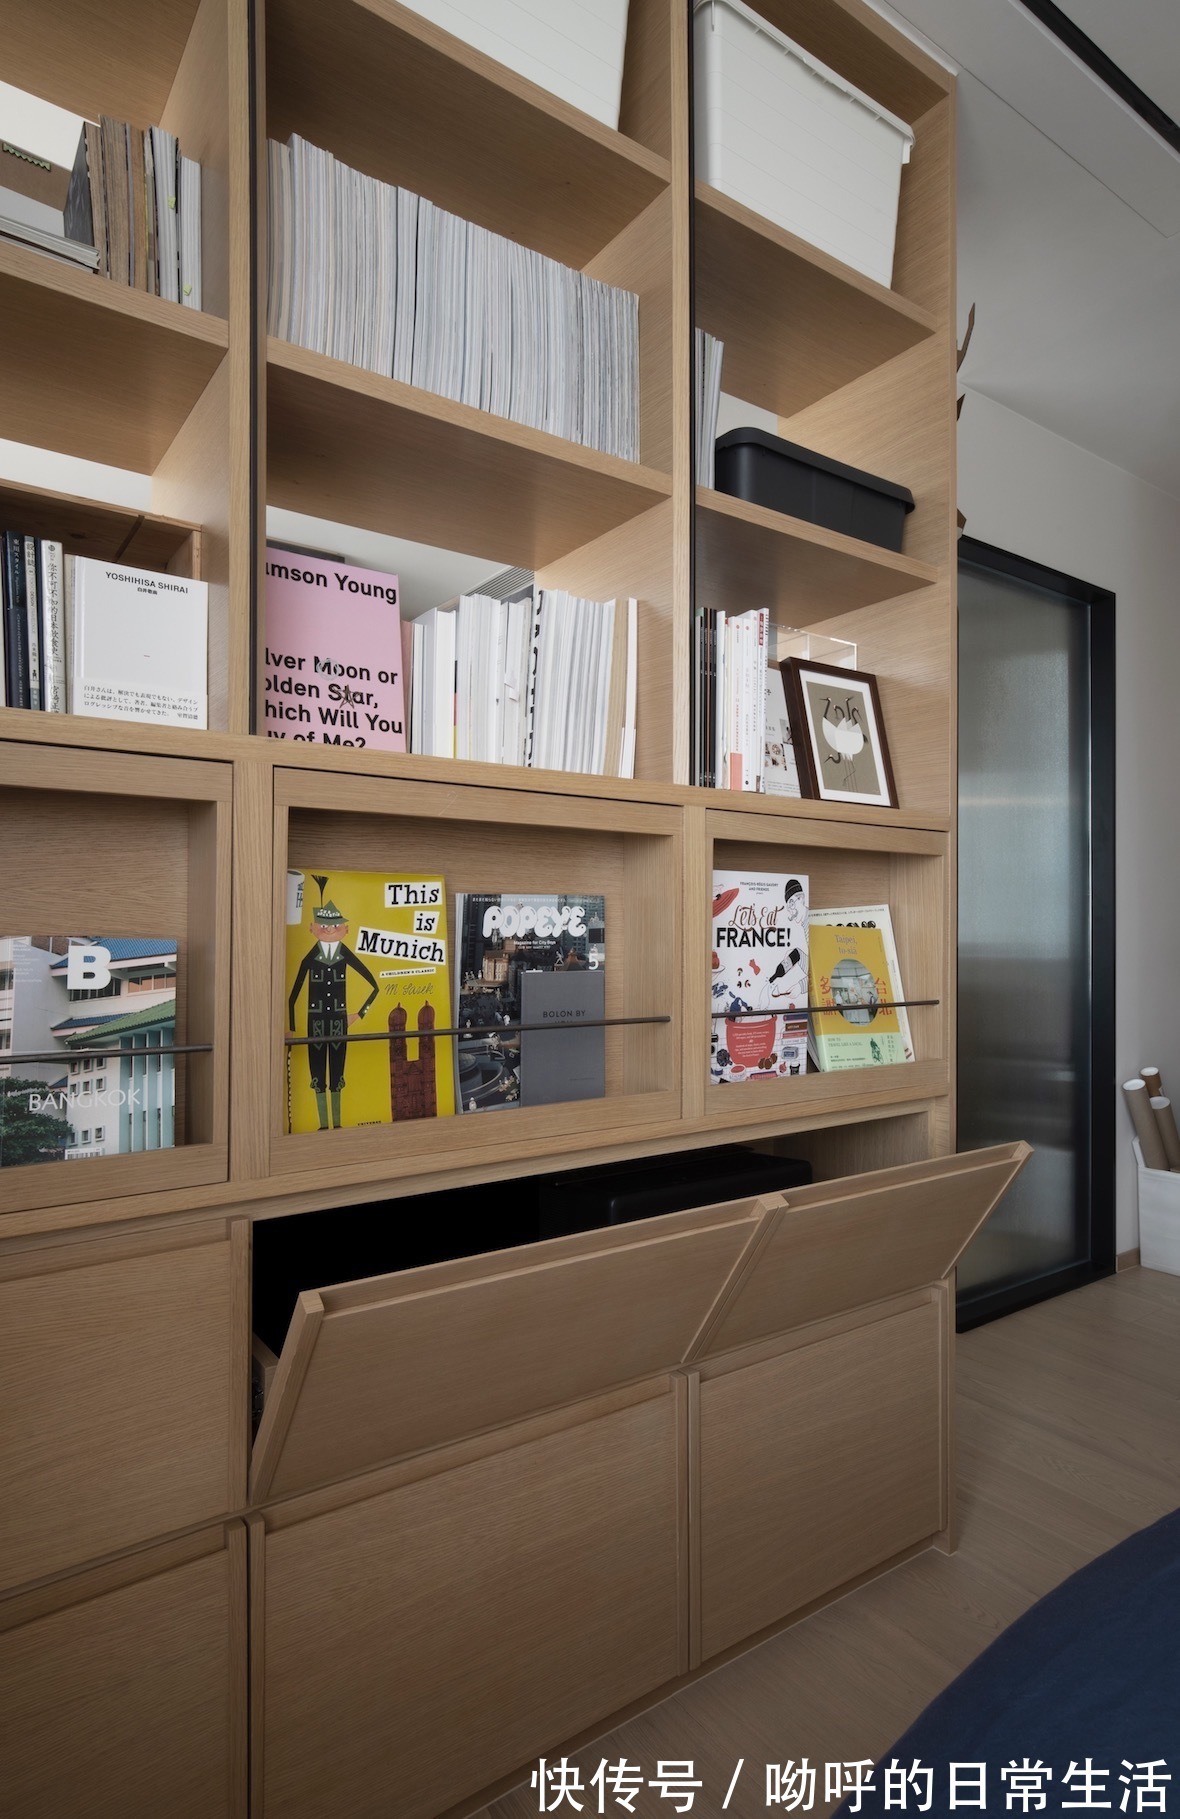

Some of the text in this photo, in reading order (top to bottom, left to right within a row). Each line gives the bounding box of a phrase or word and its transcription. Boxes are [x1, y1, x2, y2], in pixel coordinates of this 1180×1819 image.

[105, 571, 189, 594] YOSHIHISA SHIRAI
[334, 572, 397, 605] Young
[314, 655, 371, 681] Moon
[378, 670, 398, 685] or
[328, 683, 378, 709] Star,
[265, 699, 403, 734] hich Will You
[388, 884, 440, 905] This
[416, 913, 435, 932] is
[482, 905, 587, 938] POPEYE
[728, 903, 785, 932] Let's Eat
[358, 930, 445, 963] Munich
[716, 927, 791, 948] FRANCE!
[66, 945, 112, 990] B
[588, 951, 599, 970] 5
[875, 977, 892, 1015] 台北
[543, 1009, 586, 1018] BOLON BY
[28, 1088, 141, 1112] BANGKOK
